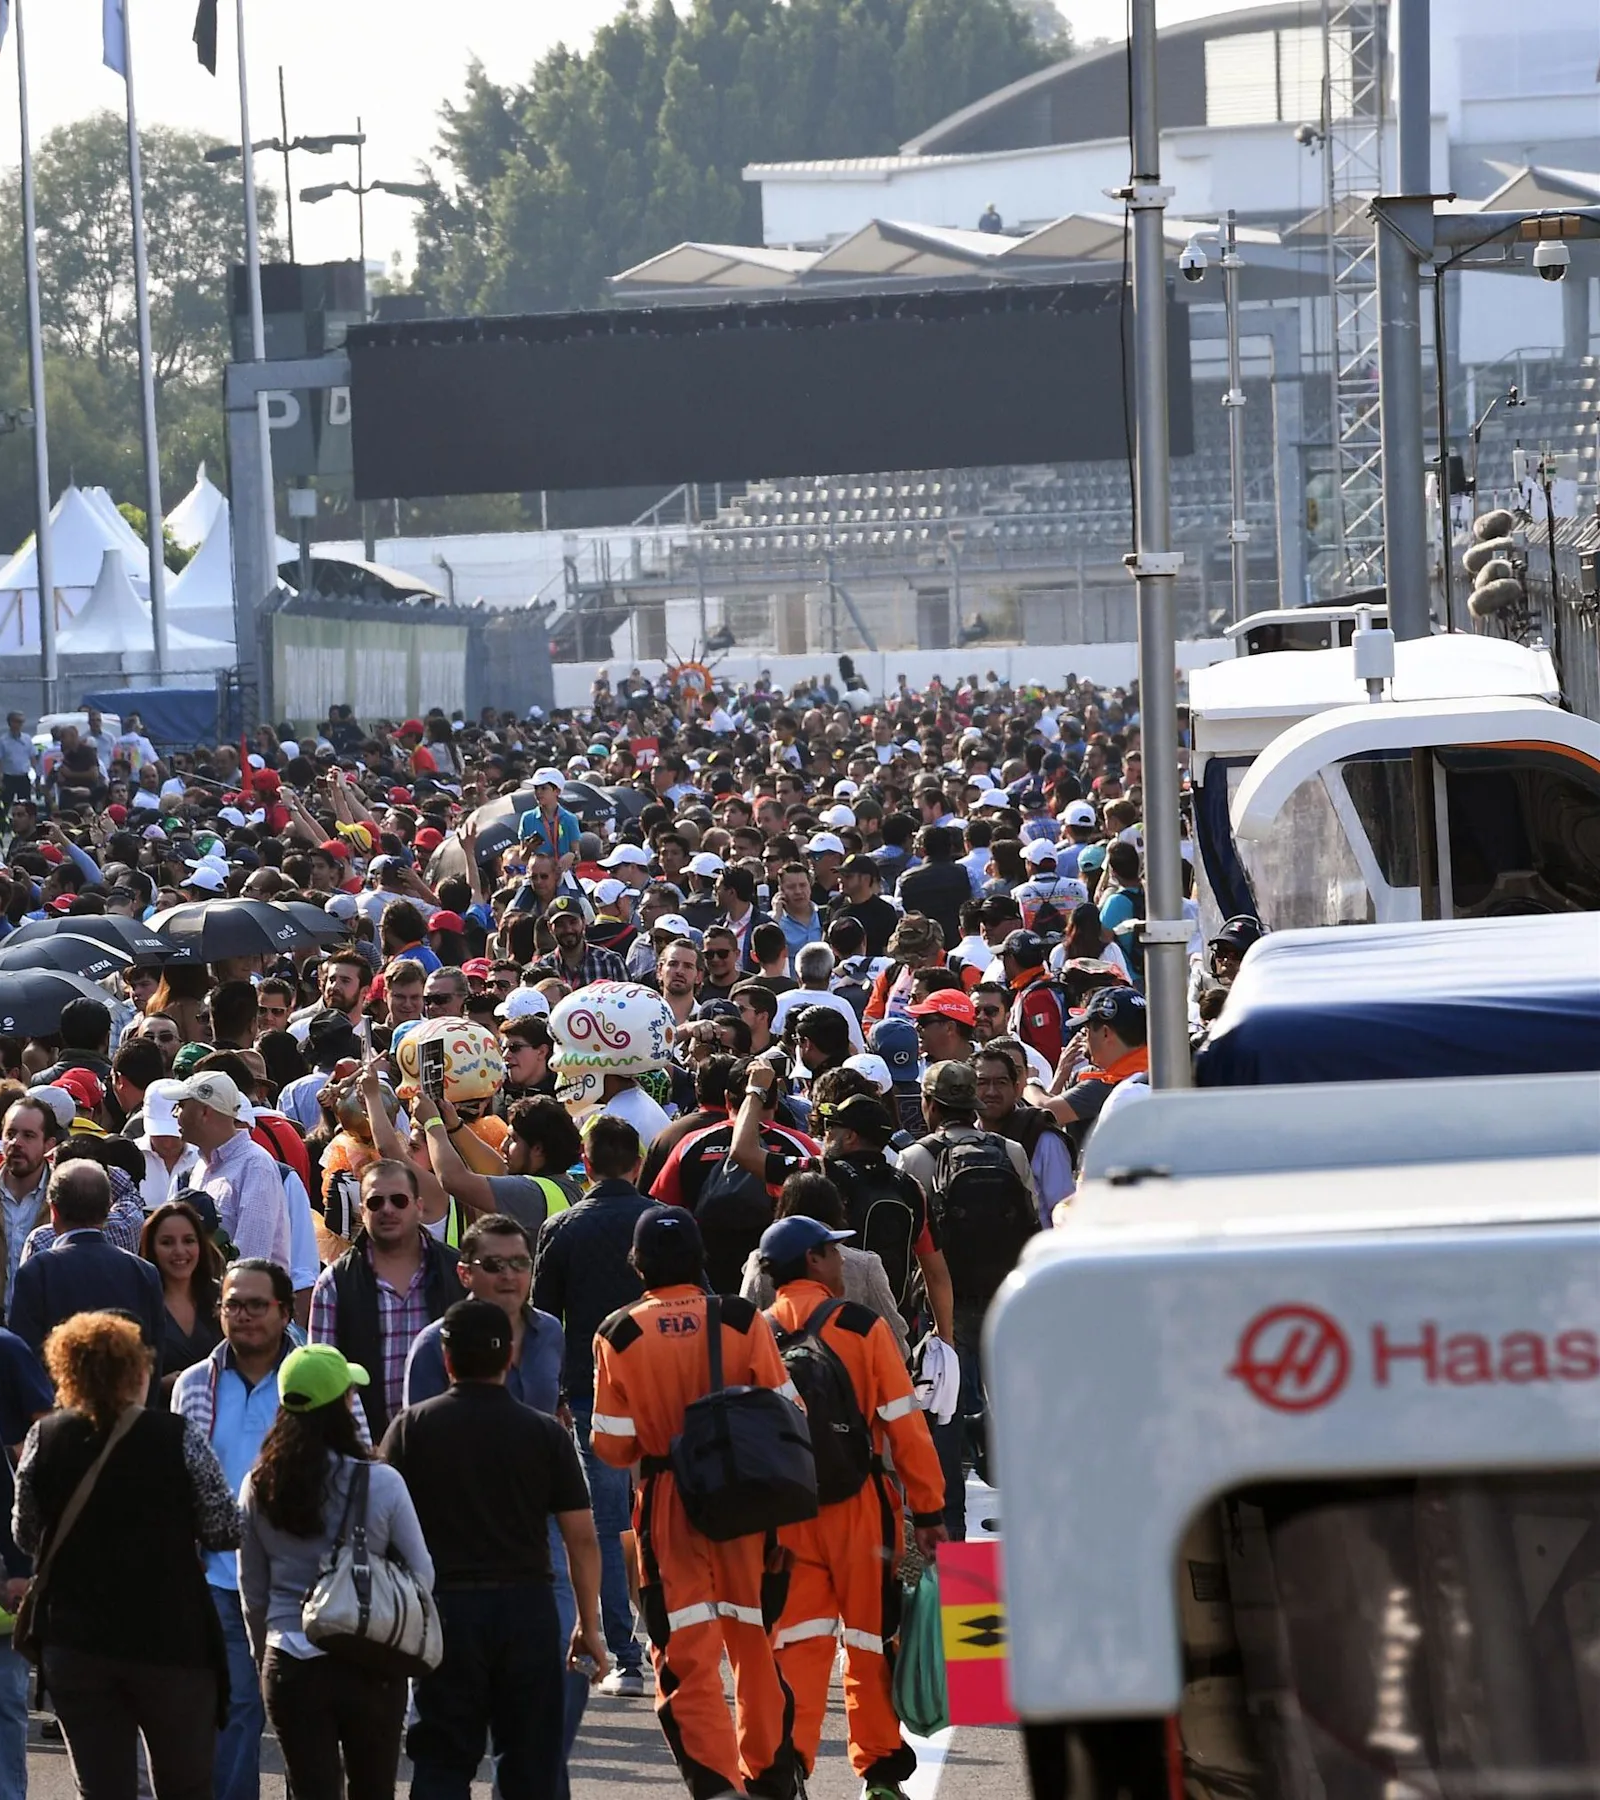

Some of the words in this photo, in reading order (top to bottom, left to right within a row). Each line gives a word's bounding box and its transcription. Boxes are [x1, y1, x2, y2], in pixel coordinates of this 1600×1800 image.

[675, 1298, 703, 1307] SAFET
[658, 1316, 697, 1333] FIA
[1371, 1320, 1599, 1389] Haas
